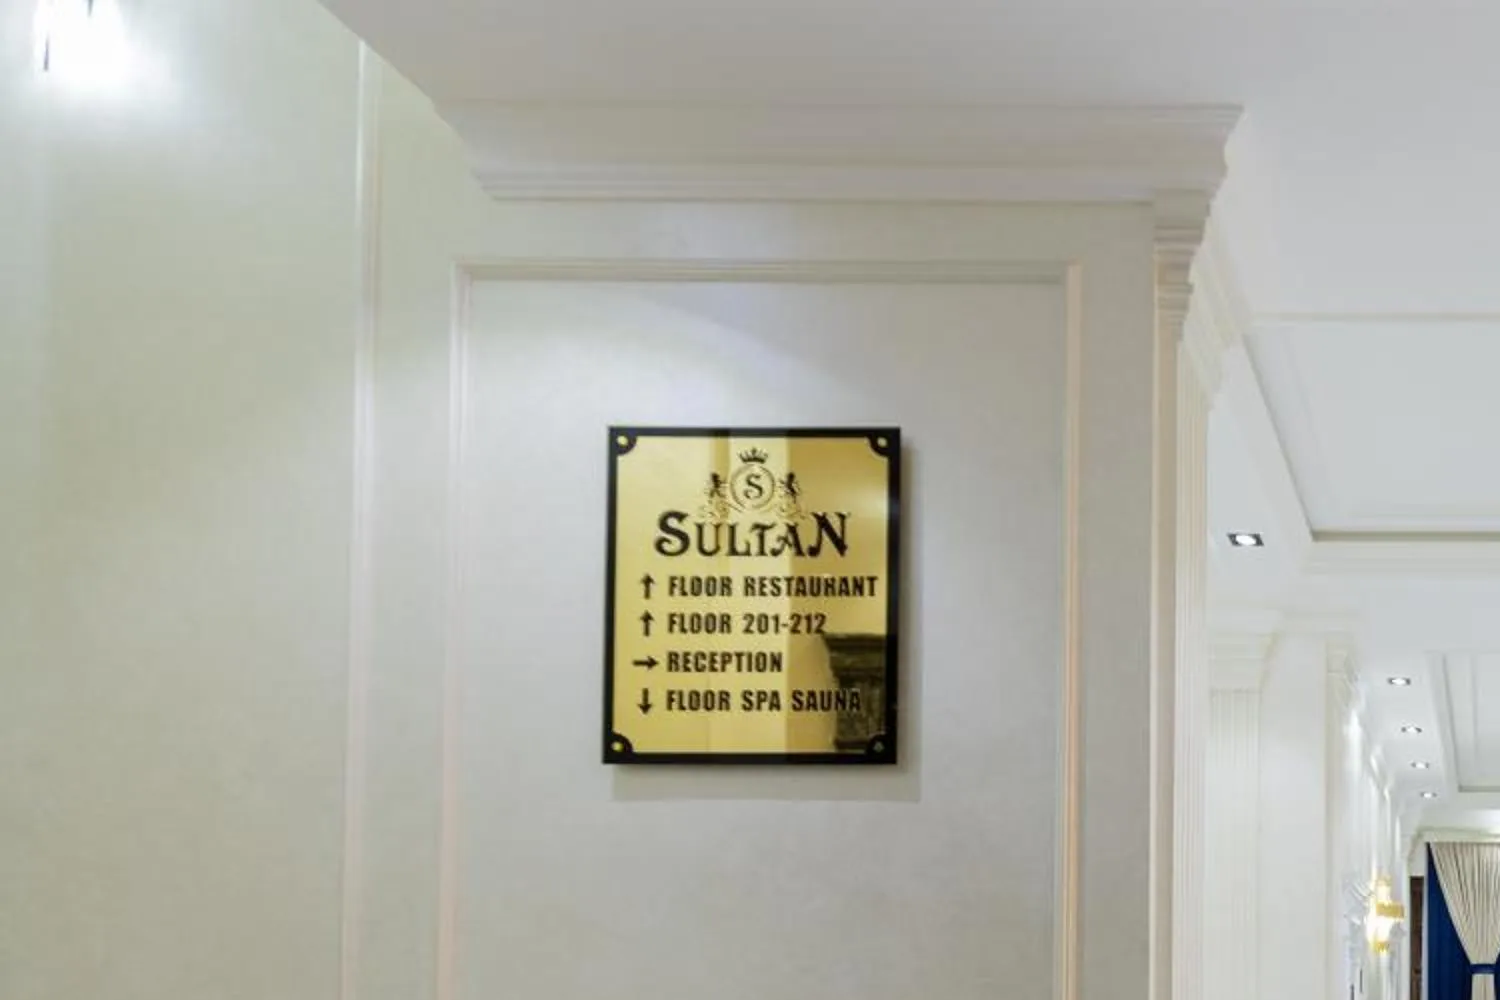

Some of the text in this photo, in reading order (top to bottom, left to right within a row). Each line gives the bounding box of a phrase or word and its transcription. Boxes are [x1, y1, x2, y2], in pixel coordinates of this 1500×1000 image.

[654, 510, 851, 557] SULTAN
[668, 575, 879, 597] FLOOR RESTAURANT
[667, 612, 827, 635] FLOOR 201-212
[666, 650, 783, 673] RECEPTION
[665, 688, 862, 712] FLOOR SPA SAUNA
